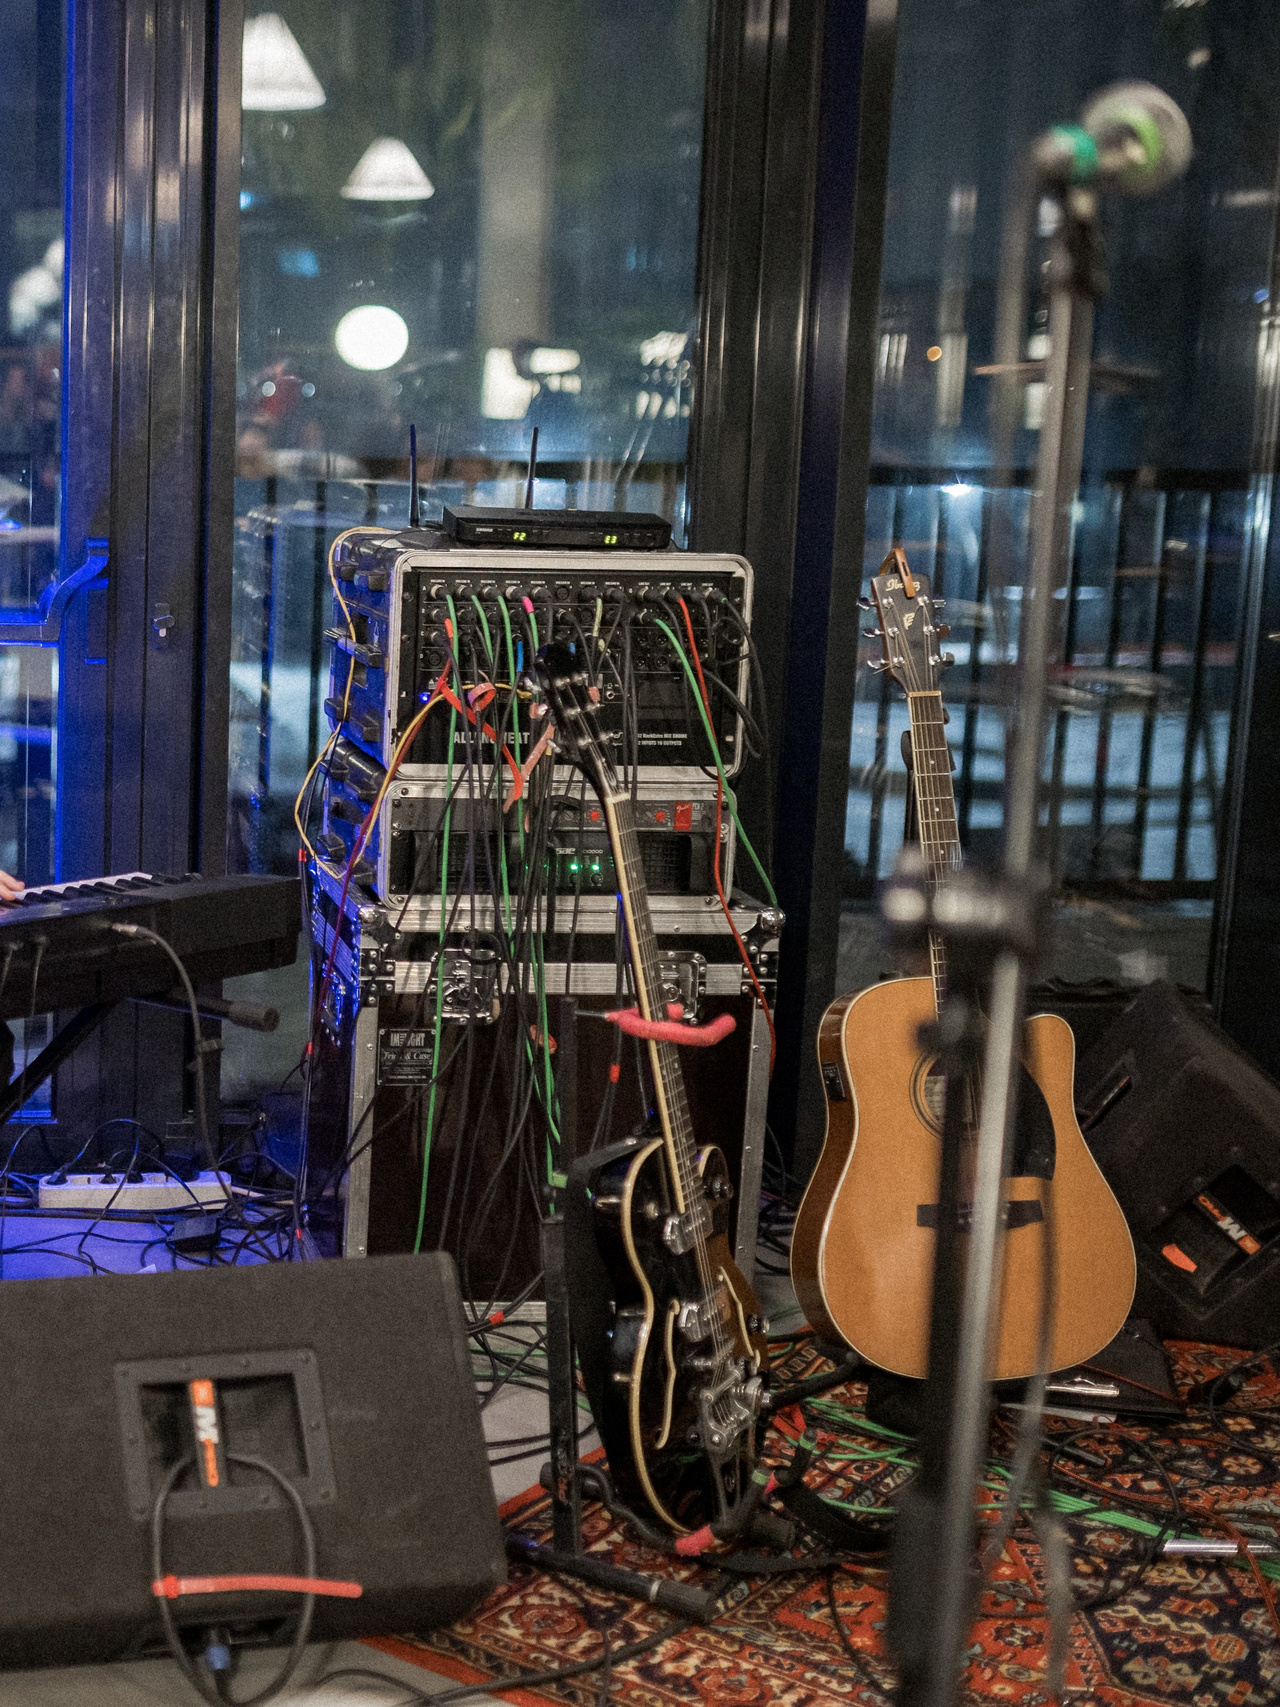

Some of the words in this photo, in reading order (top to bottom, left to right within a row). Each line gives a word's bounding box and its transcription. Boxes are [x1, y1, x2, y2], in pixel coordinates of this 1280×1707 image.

[513, 531, 527, 541] F2
[604, 535, 618, 544] E3
[885, 578, 921, 592] Ibaz
